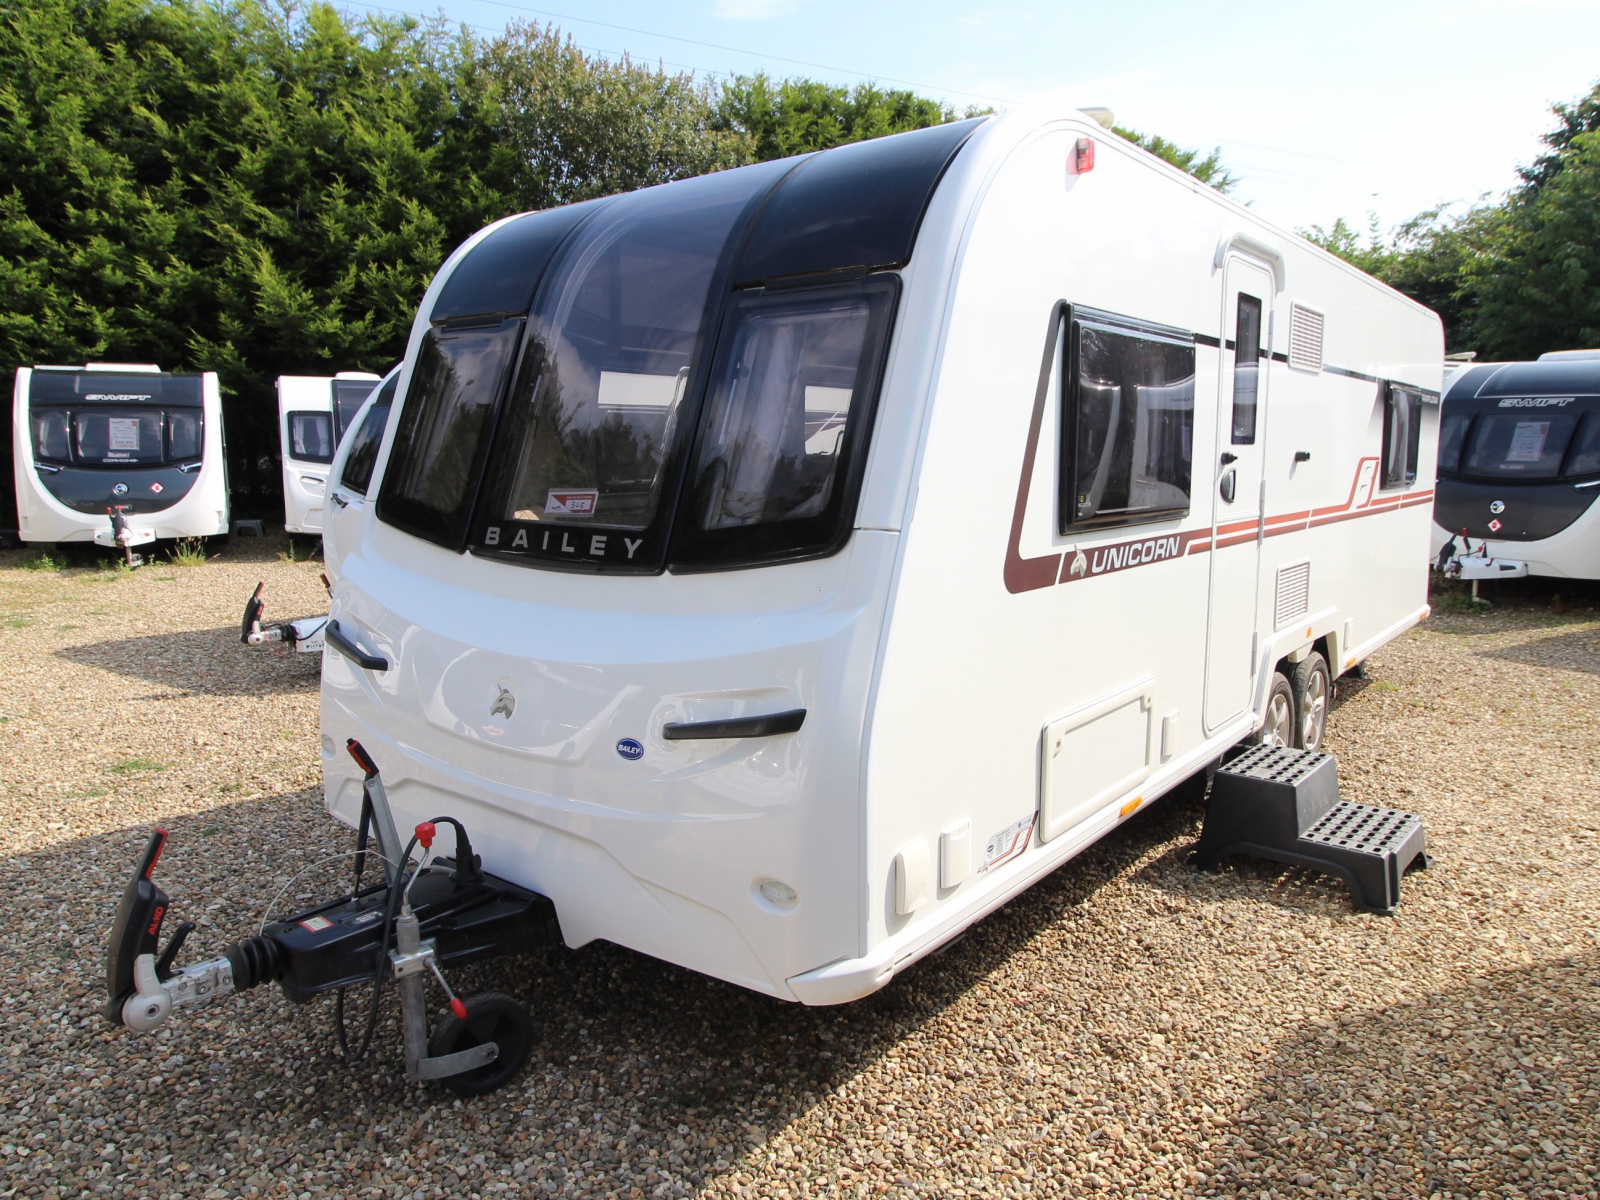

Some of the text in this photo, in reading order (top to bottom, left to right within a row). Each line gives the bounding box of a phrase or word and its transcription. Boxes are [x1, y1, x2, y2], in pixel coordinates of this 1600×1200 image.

[1498, 397, 1575, 407] SWIFT
[485, 526, 643, 559] BAILEY
[1091, 536, 1180, 573] UNICORN
[618, 744, 641, 754] BAILEY
